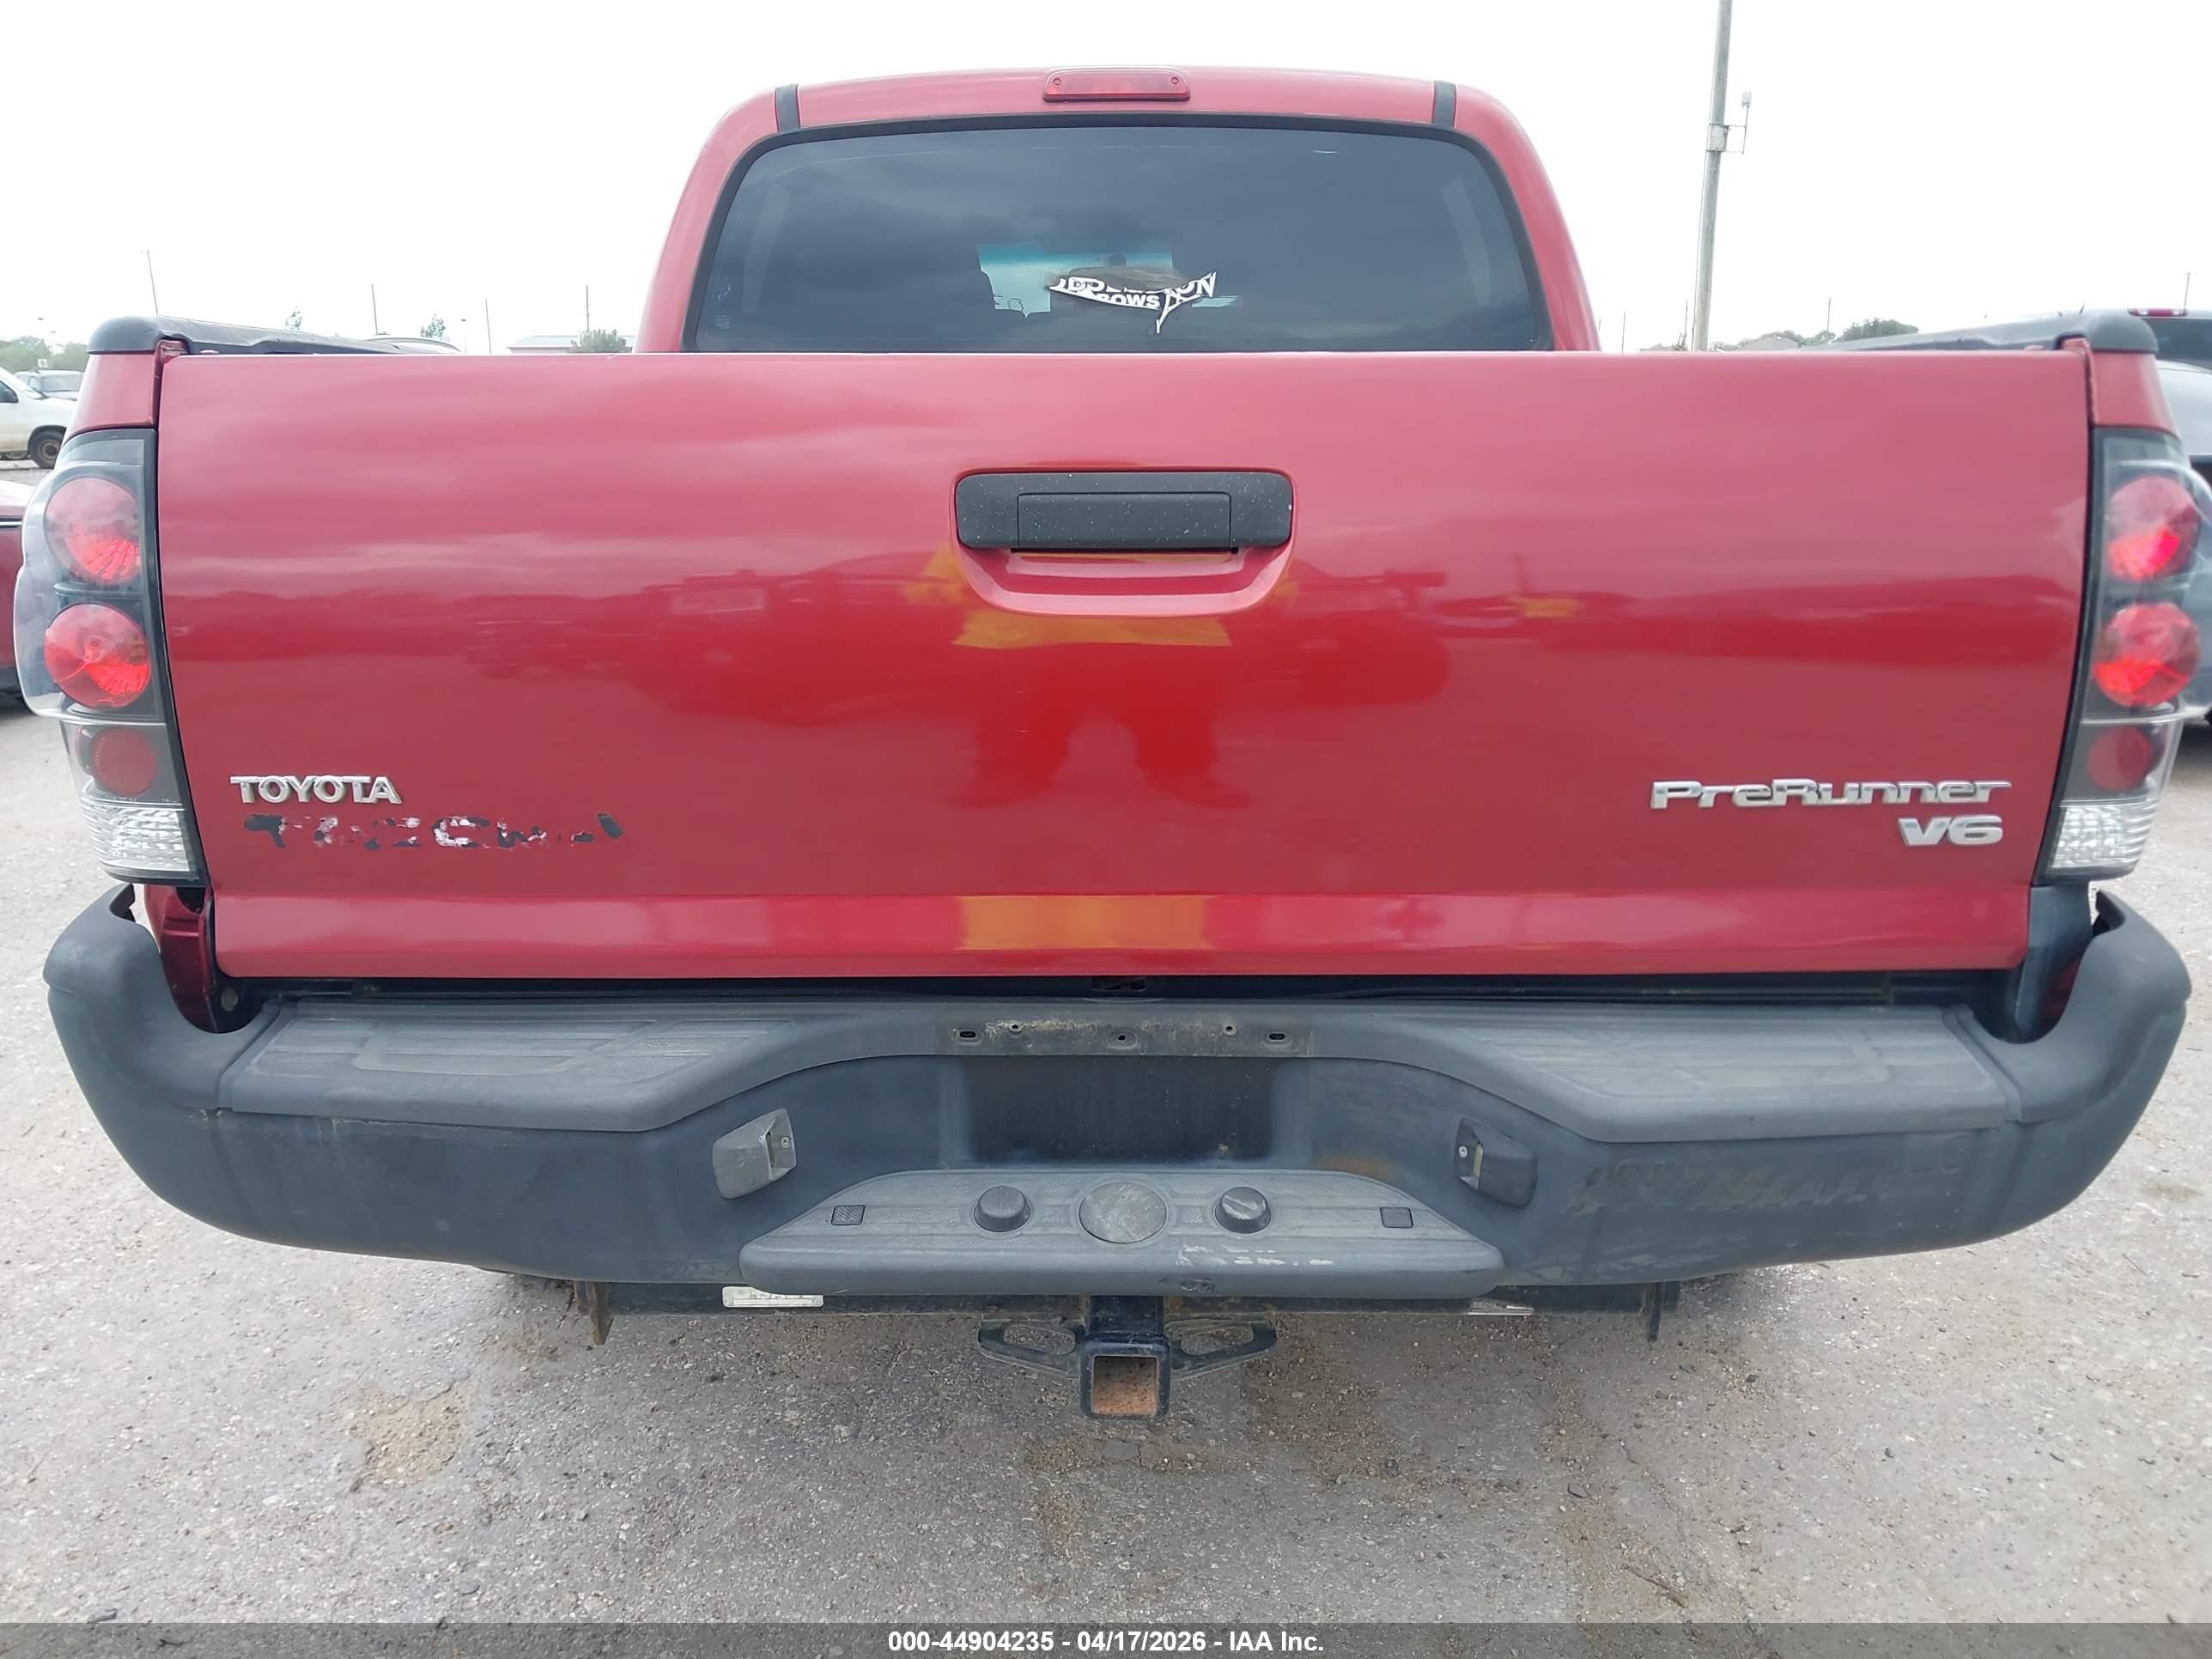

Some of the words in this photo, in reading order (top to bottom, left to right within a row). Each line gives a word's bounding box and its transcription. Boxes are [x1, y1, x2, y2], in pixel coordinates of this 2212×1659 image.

[230, 775, 402, 805] TOYOTA
[1650, 778, 2012, 810] PreRunner
[1898, 815, 2003, 847] V6
